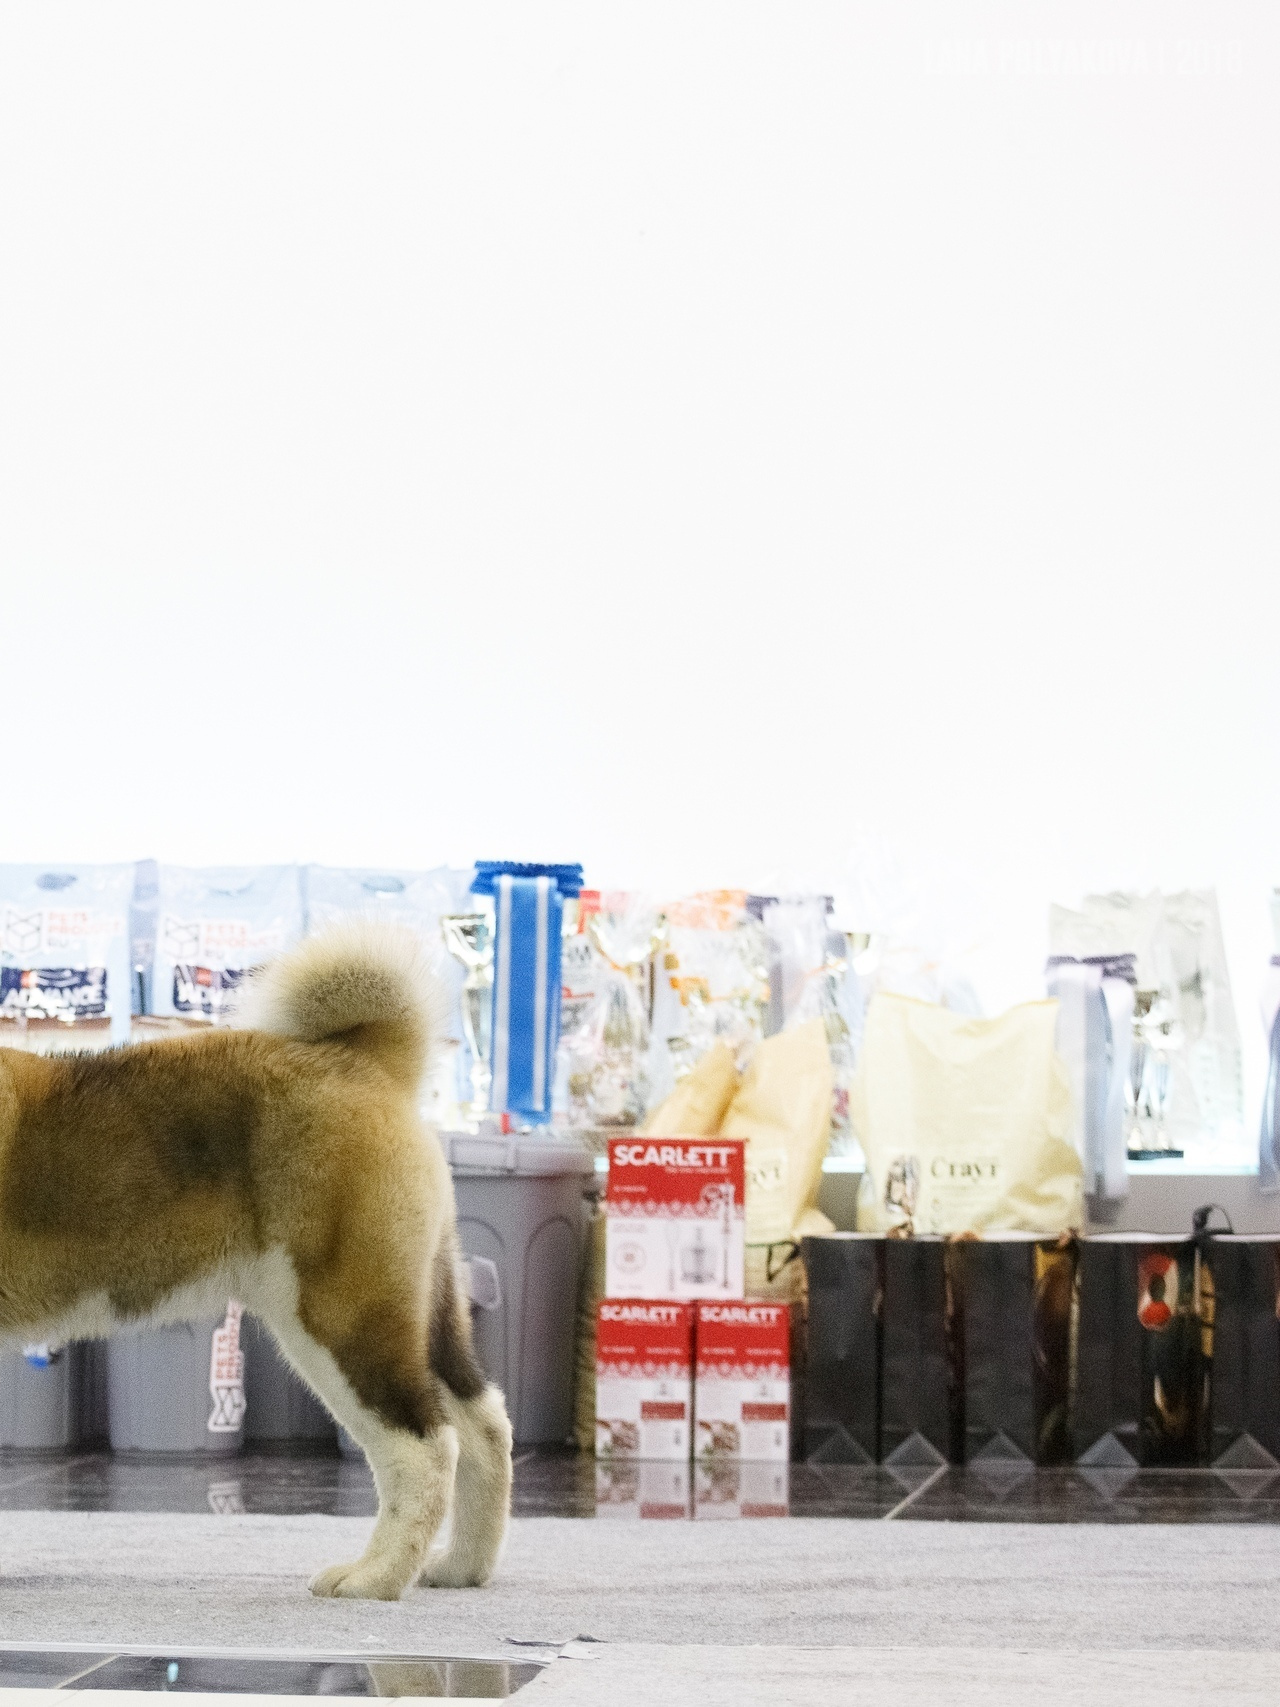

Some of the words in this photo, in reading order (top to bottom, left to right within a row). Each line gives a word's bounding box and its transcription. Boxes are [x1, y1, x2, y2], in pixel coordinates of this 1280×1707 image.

[614, 1144, 738, 1167] SCARLETT
[600, 1304, 683, 1322] SCARLETT
[700, 1306, 784, 1323] SCARLETT
